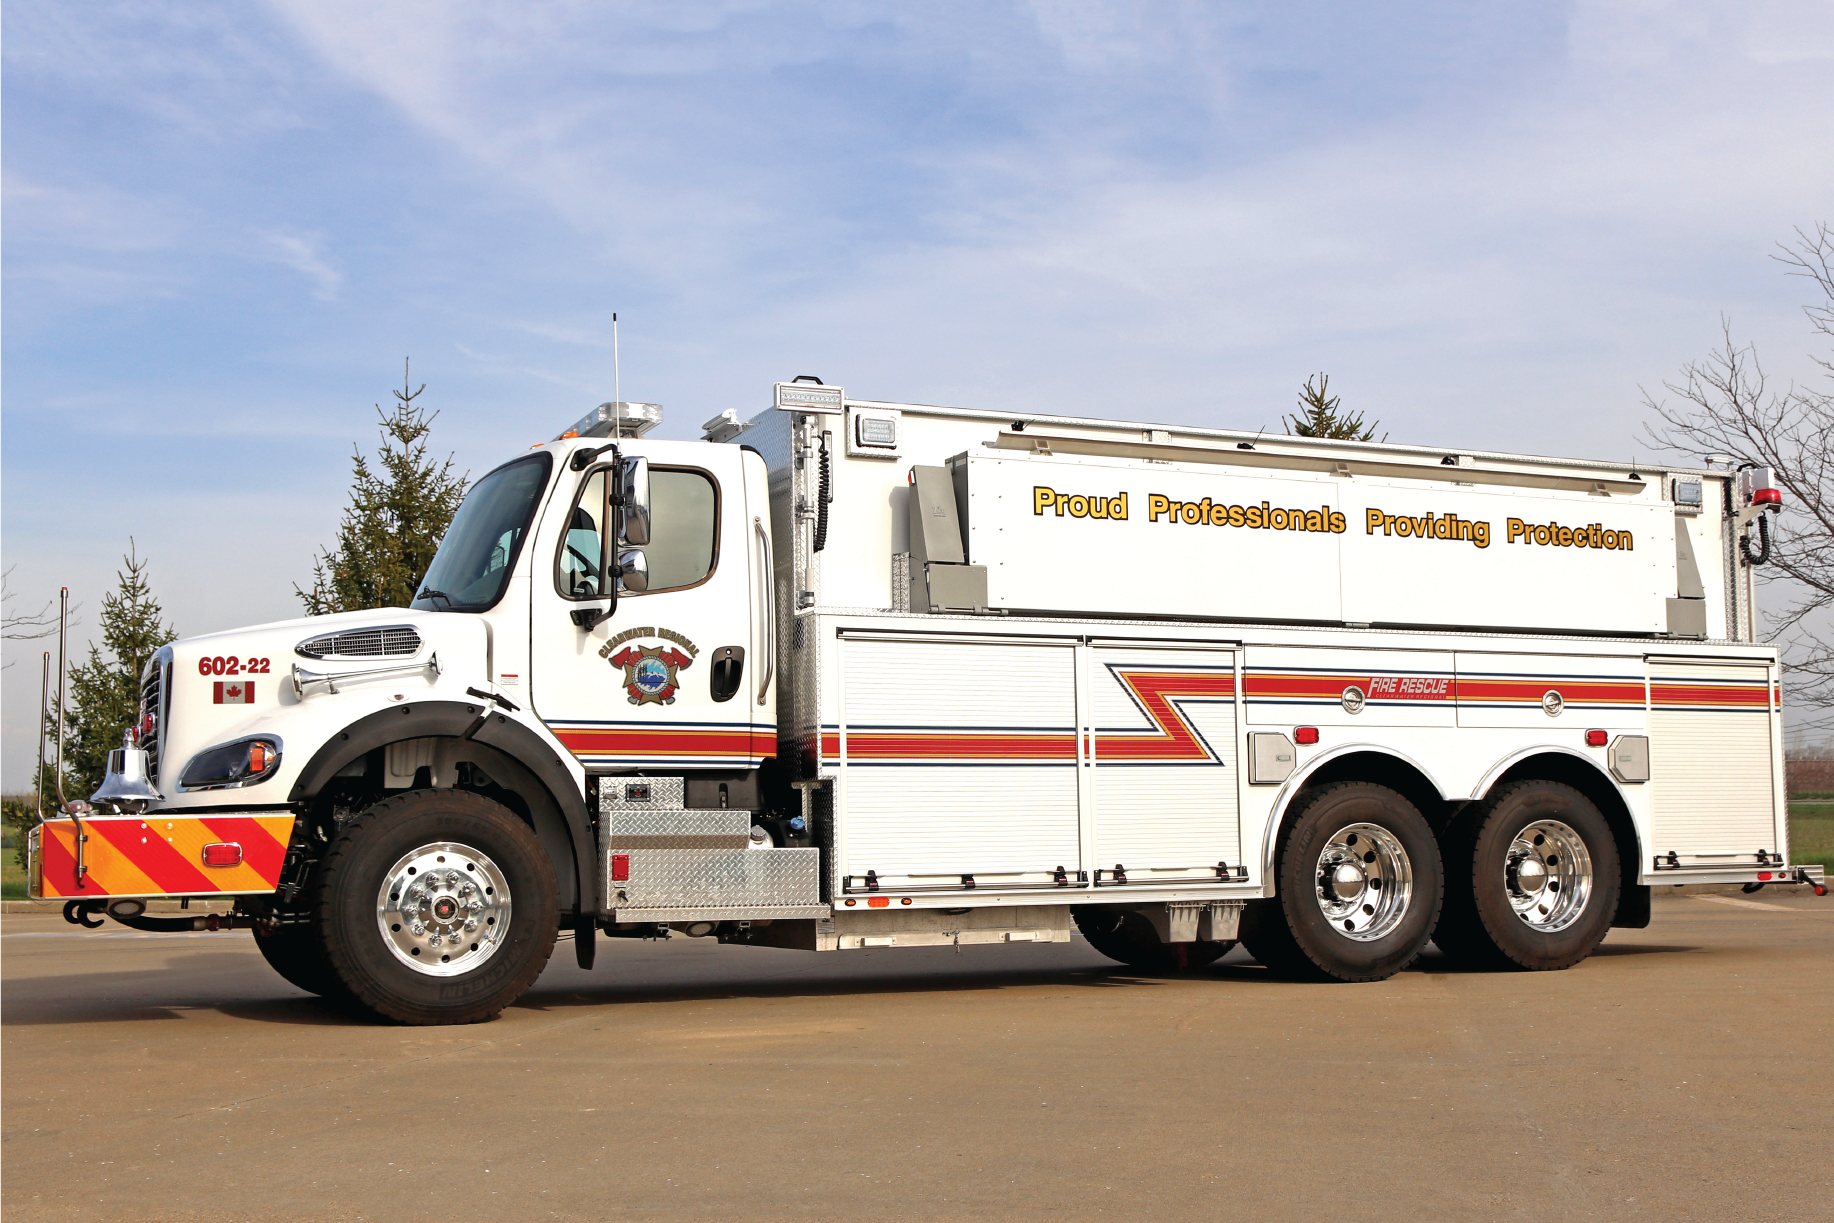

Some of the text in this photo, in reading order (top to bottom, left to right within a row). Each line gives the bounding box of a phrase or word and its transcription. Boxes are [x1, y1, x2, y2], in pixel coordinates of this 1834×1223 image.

[1033, 486, 1633, 551] Proud Professionals Providing Protection
[598, 626, 700, 659] CLEARWATER REGIONAL
[198, 655, 271, 676] 602-22
[1367, 677, 1450, 698] FIRE RESCUE
[441, 942, 524, 999] MICHELIN
